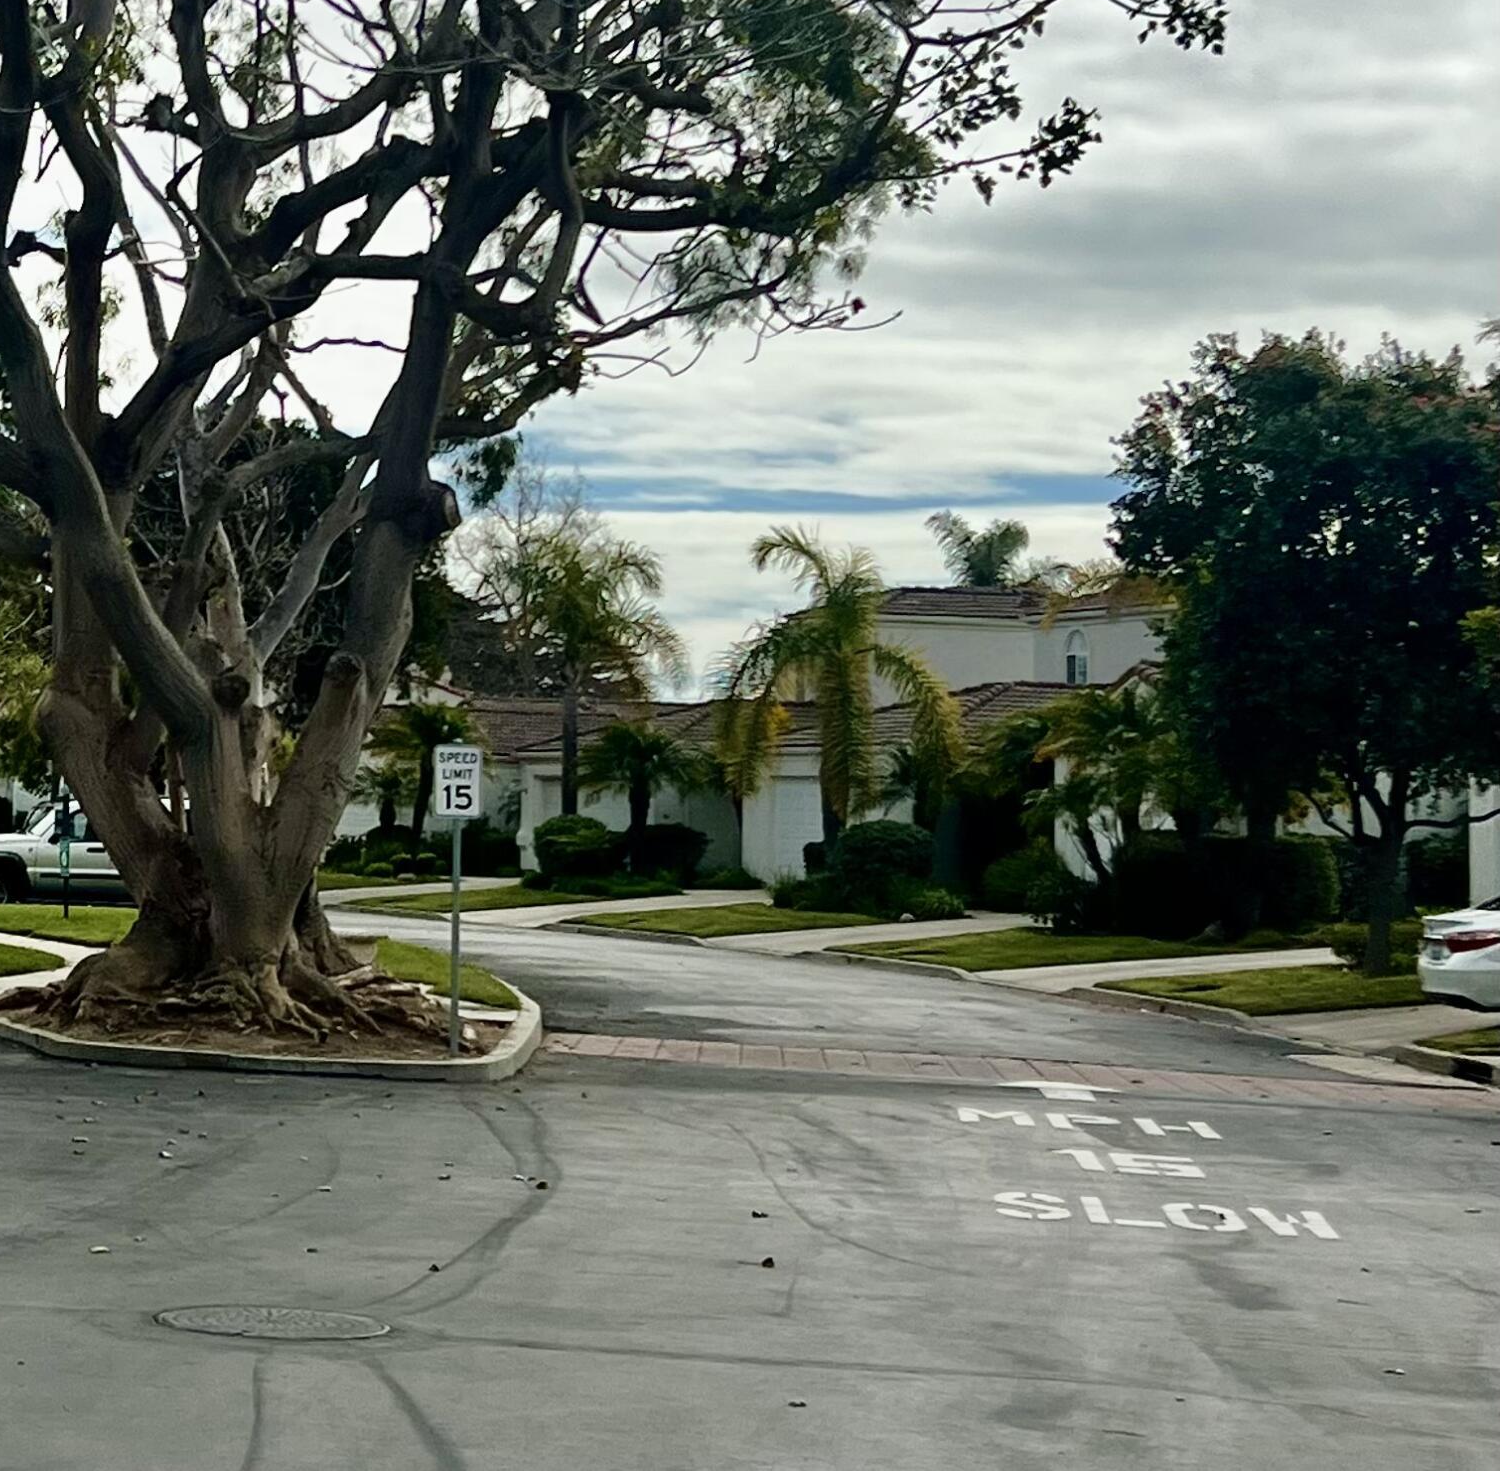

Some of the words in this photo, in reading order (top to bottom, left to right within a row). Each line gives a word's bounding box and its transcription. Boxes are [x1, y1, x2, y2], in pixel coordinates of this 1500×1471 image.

[438, 751, 478, 764] SPEED
[442, 768, 473, 780] LIMIT
[443, 784, 473, 811] 15
[956, 1106, 1223, 1140] MPH
[1051, 1148, 1206, 1178] 15
[993, 1191, 1341, 1240] SLOW
